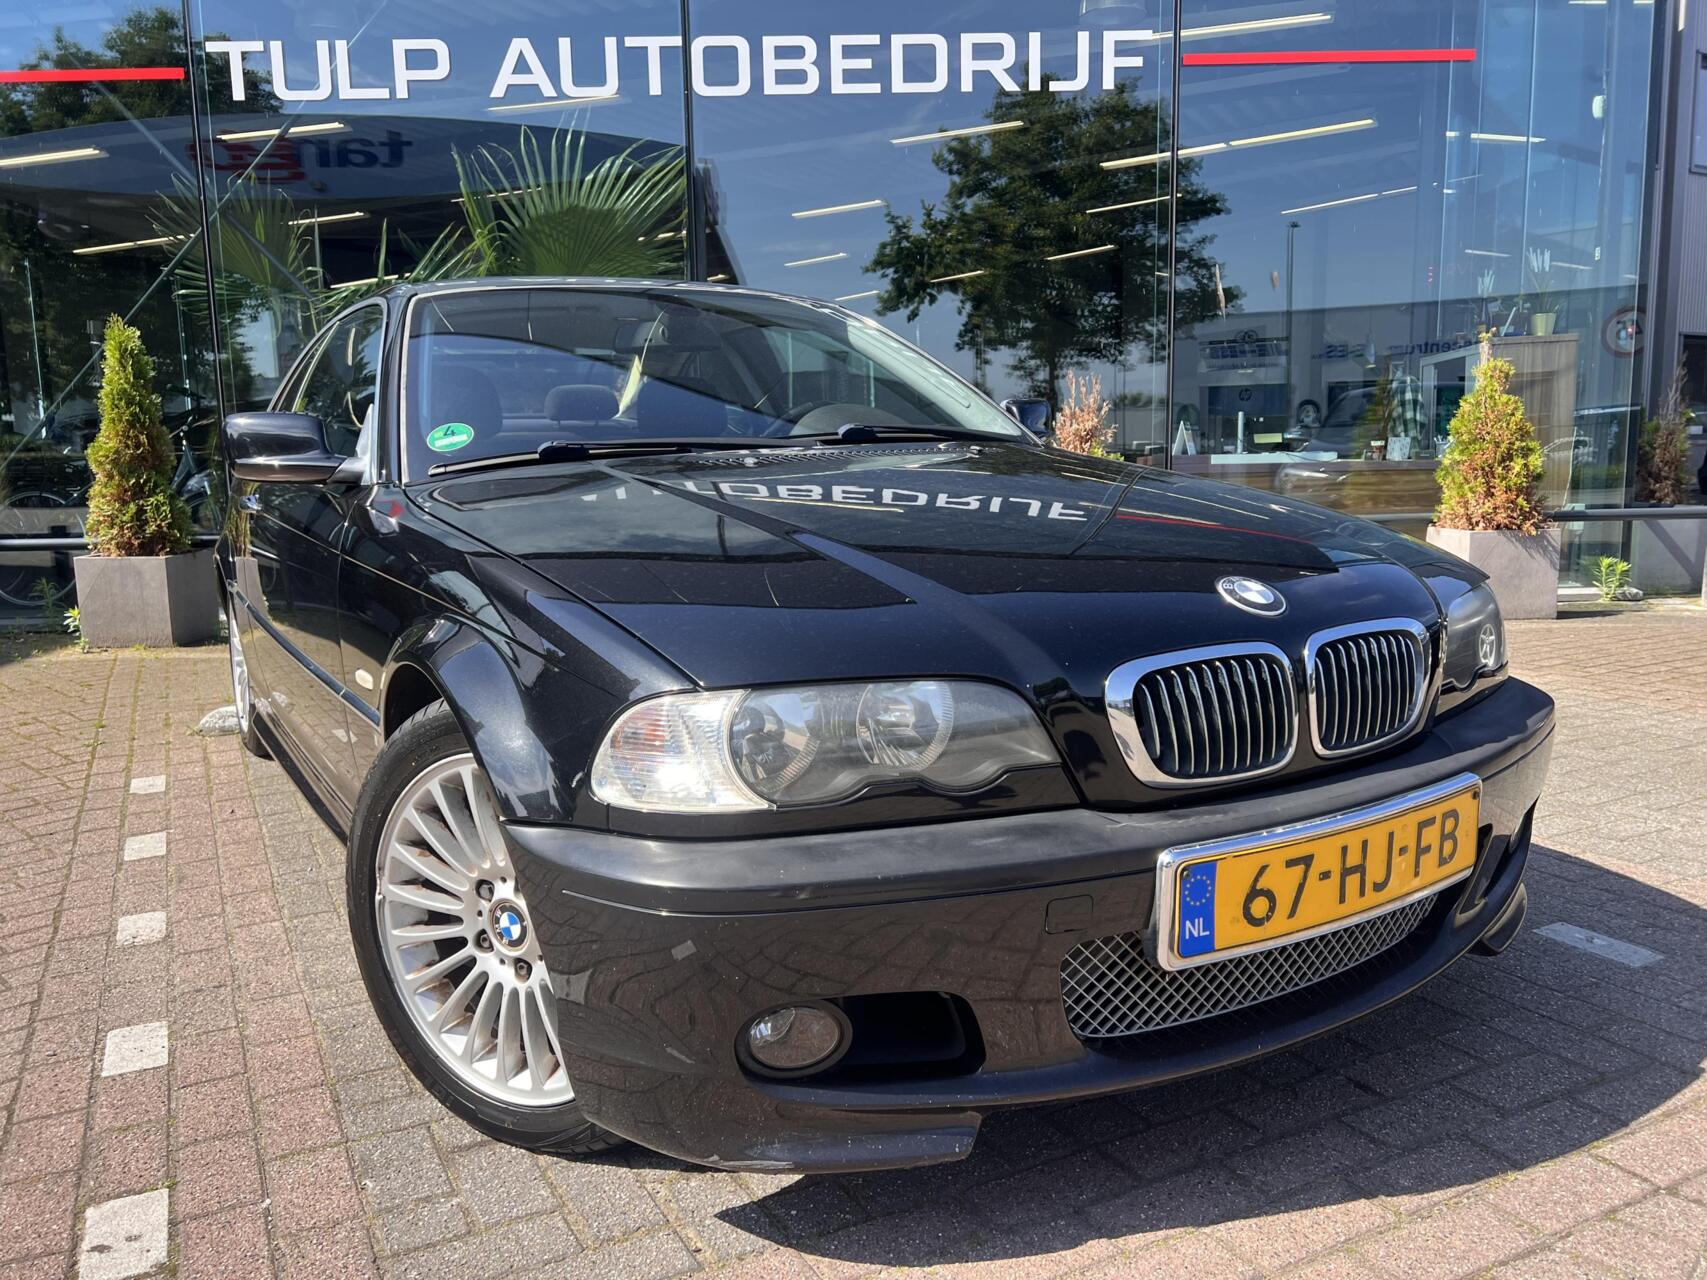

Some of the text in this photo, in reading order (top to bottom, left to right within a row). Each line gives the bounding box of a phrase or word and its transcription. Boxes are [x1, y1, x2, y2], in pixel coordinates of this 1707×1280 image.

[205, 29, 1154, 101] TULP AUTOBEDRIJF
[1242, 808, 1460, 928] 67-HJ-FB
[1184, 917, 1210, 938] NL
